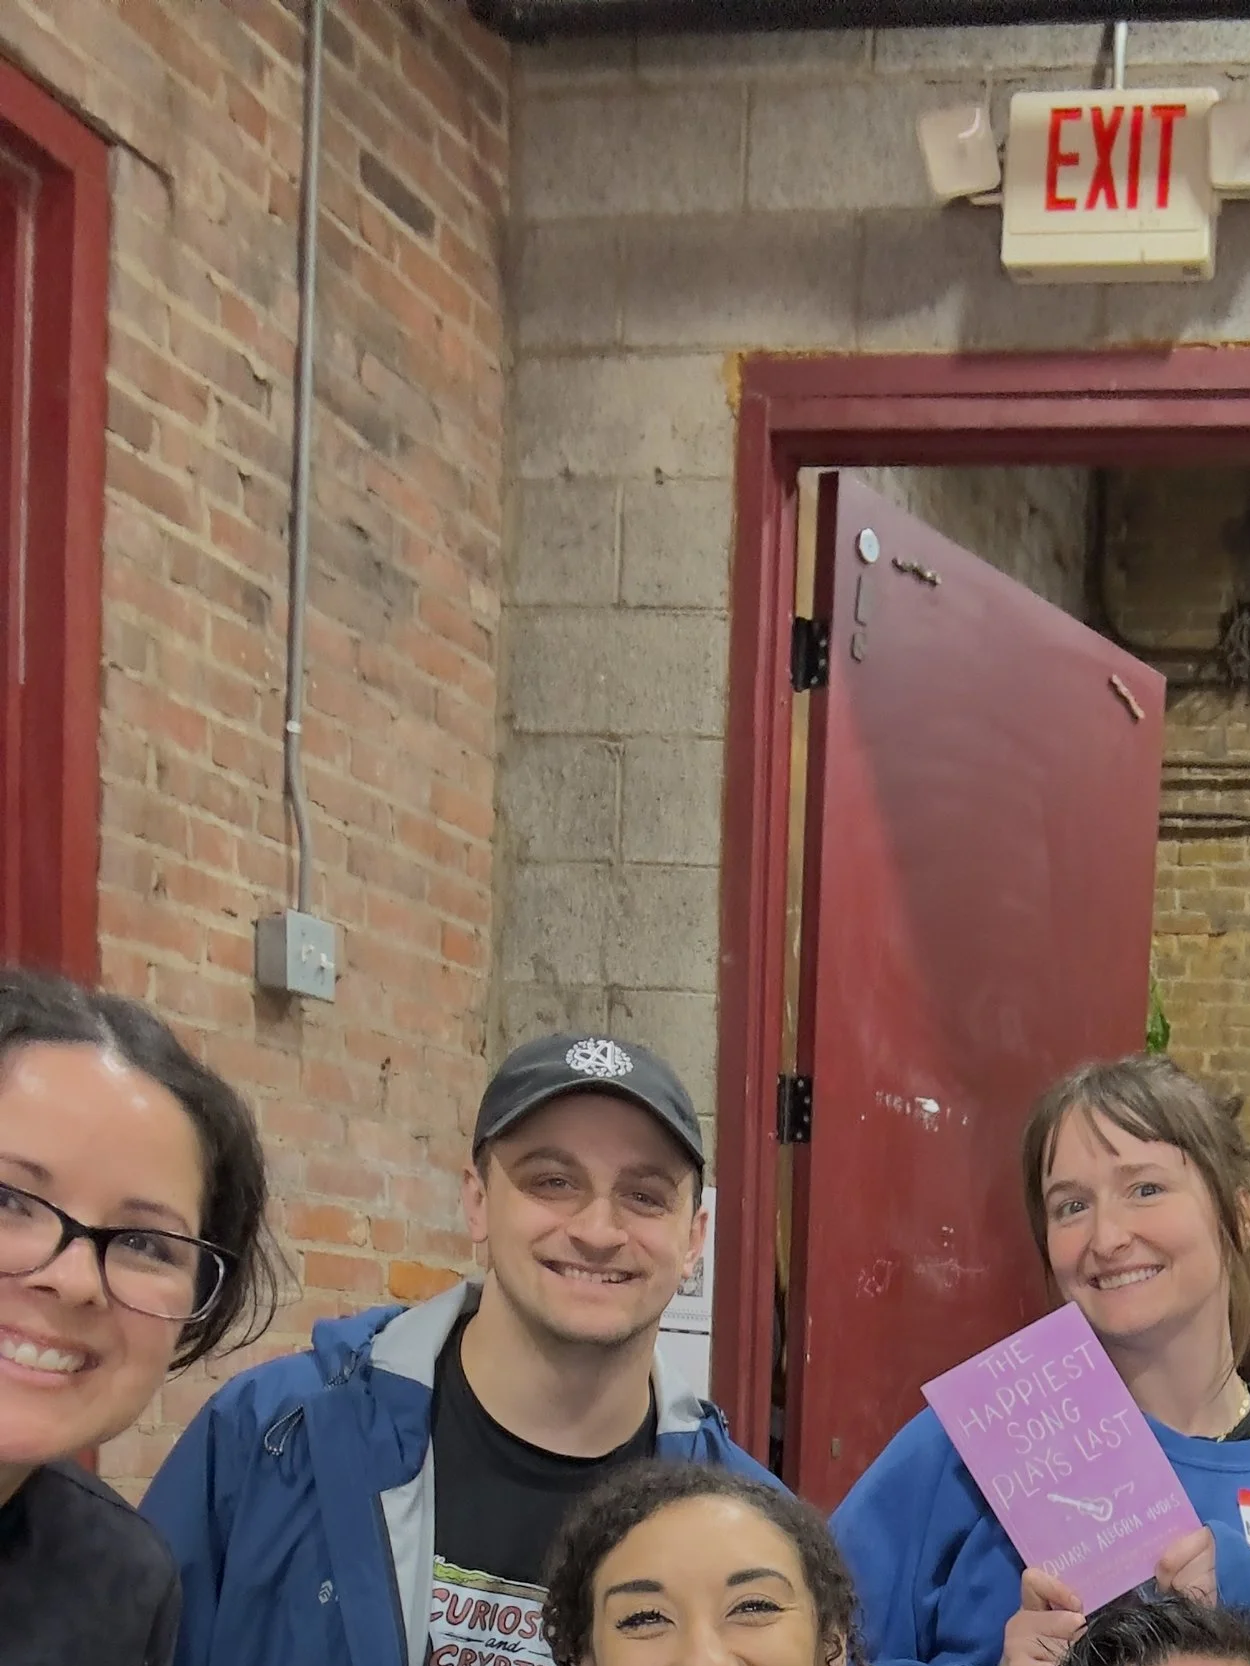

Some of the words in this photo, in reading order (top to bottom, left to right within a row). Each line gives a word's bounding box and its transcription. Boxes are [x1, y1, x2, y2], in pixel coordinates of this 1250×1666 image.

[1044, 103, 1187, 212] EXIT
[976, 1338, 1036, 1381] THE
[957, 1339, 1102, 1441] HAPPIEST
[1006, 1396, 1083, 1455] SONG
[991, 1449, 1074, 1511] PLAYS
[1073, 1408, 1136, 1463] LAST
[430, 1587, 545, 1641] CURIOS
[484, 1636, 524, 1653] and
